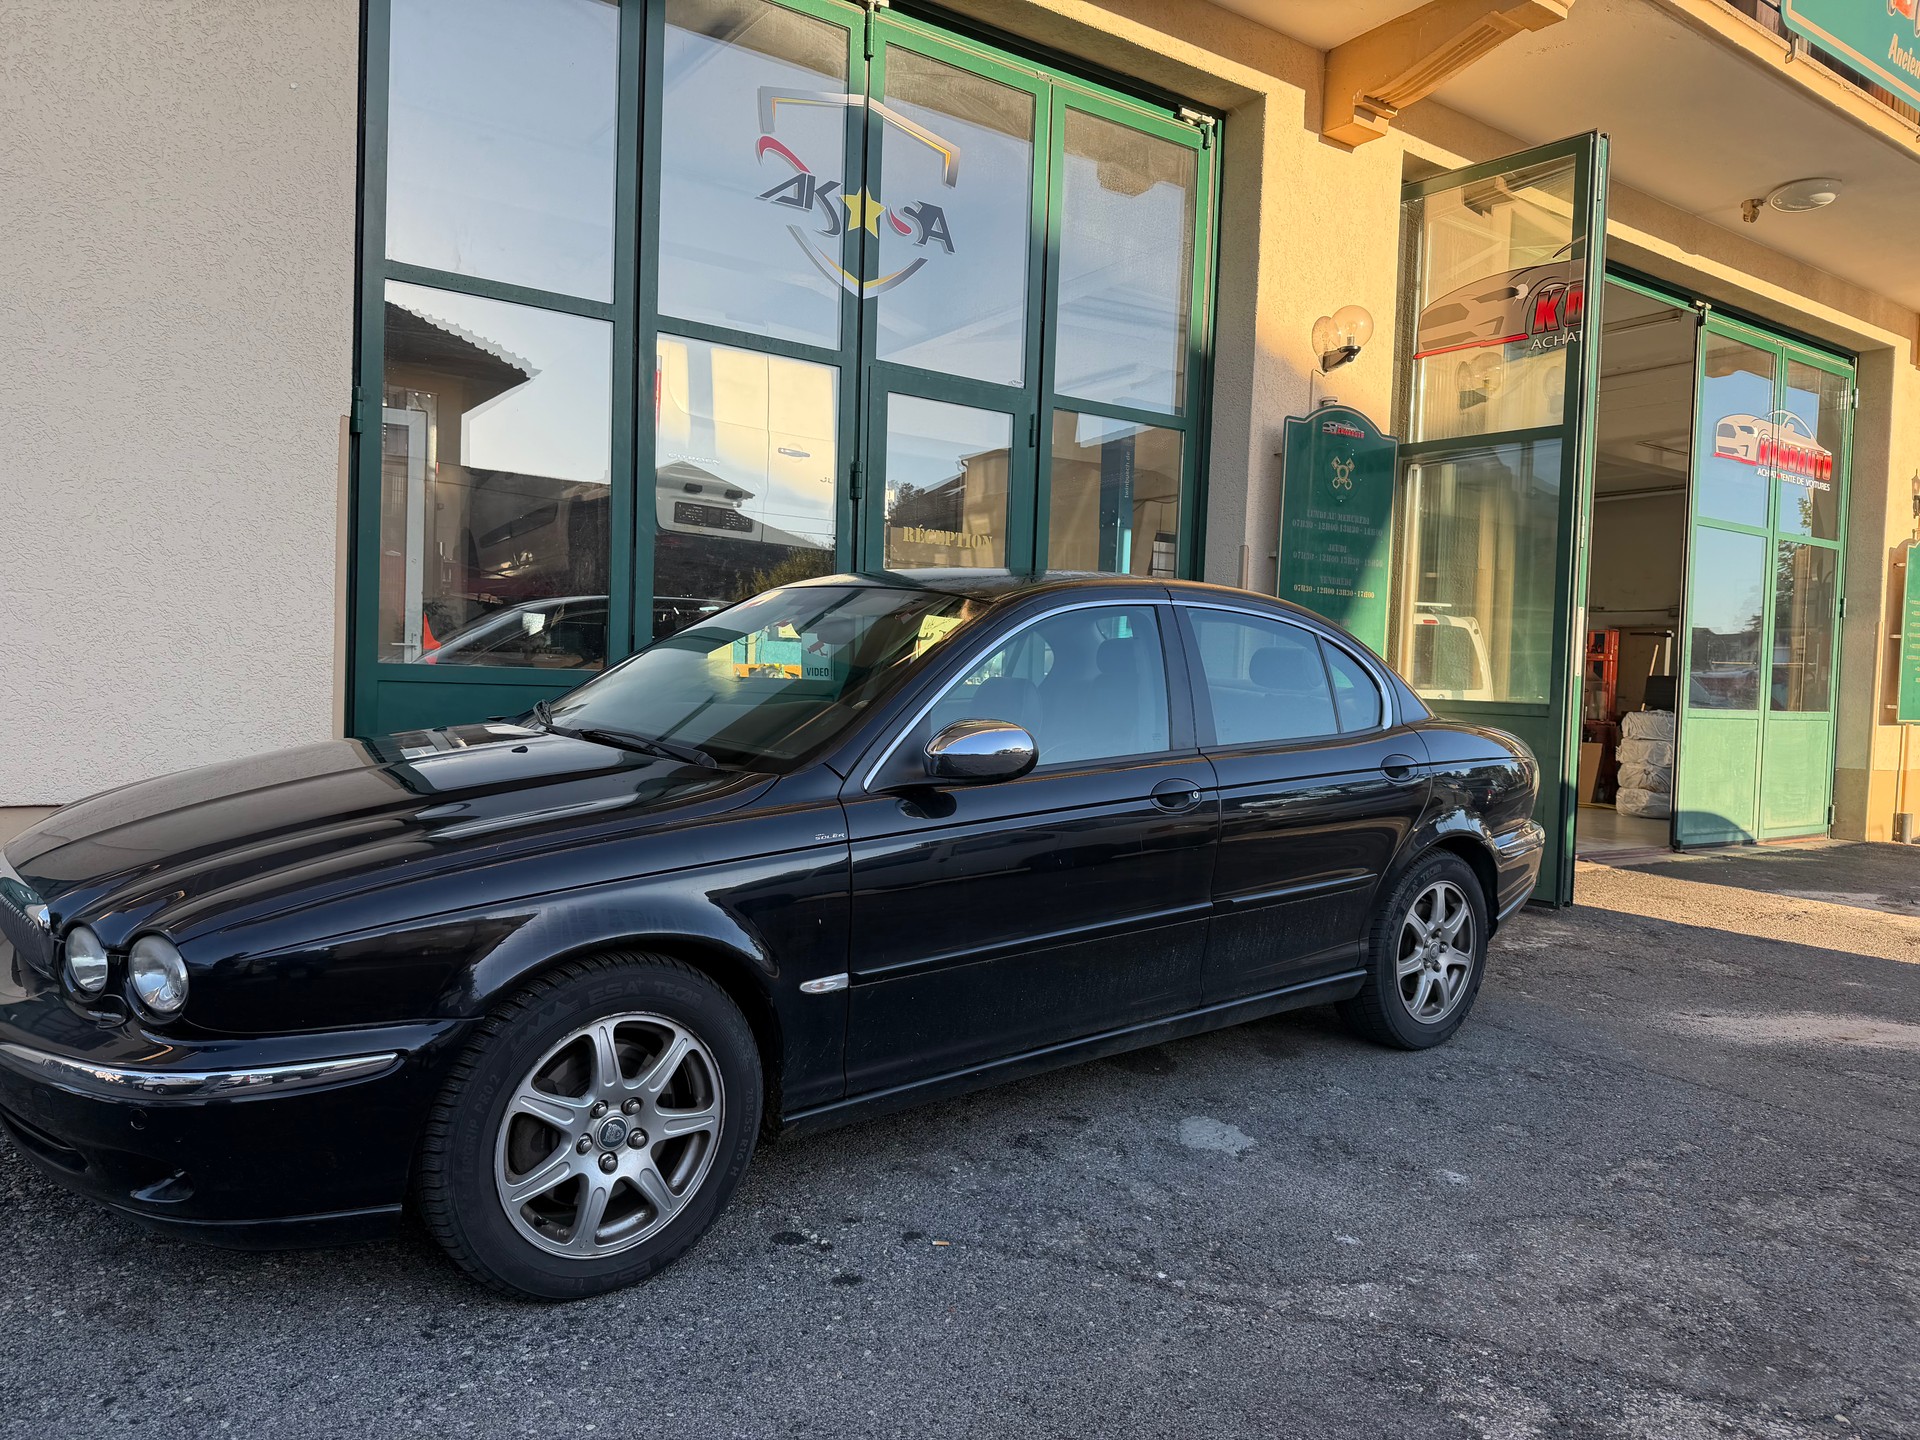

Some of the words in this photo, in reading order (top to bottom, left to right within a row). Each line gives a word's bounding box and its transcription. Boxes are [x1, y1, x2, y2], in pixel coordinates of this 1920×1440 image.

[903, 524, 993, 549] RÉCEPTION
[1293, 584, 1313, 592] 07H30
[1316, 586, 1335, 595] 12H00
[1336, 588, 1354, 597] 13H30
[806, 667, 829, 677] VIDEO
